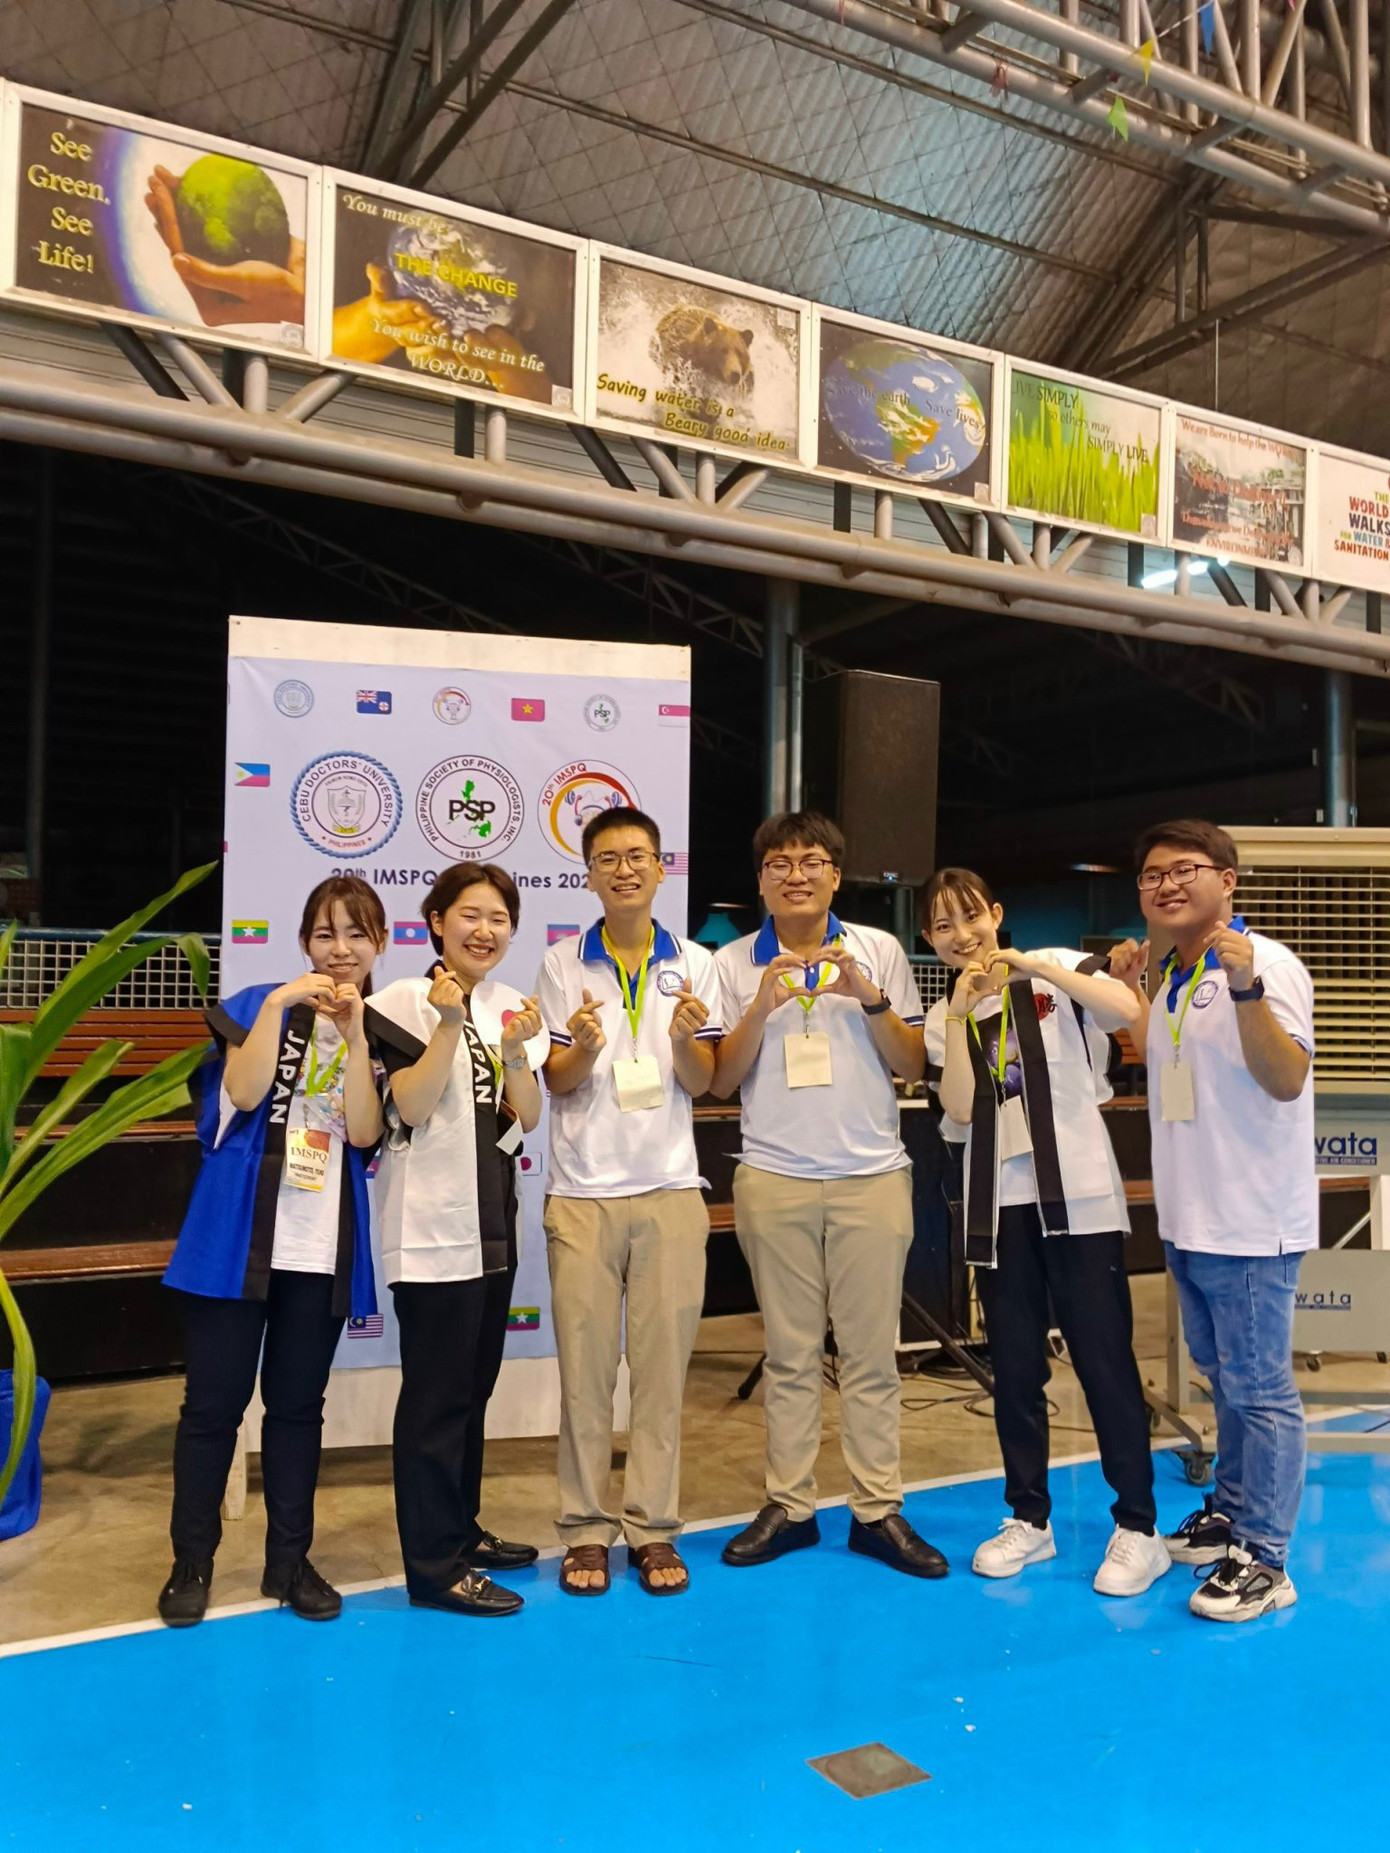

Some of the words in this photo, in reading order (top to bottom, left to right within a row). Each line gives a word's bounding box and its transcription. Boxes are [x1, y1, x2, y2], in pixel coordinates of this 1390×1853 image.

[50, 132, 92, 161] See
[51, 207, 93, 237] See
[342, 194, 378, 217] You
[382, 206, 421, 228] must
[38, 240, 94, 274] Life!
[395, 252, 432, 276] THE
[438, 264, 518, 298] CHANGE
[373, 318, 402, 339] You
[409, 331, 448, 349] wish
[452, 338, 469, 354] to
[472, 345, 496, 360] see
[499, 348, 516, 365] in
[520, 353, 545, 372] the
[596, 373, 647, 402] Saving
[655, 390, 700, 411] water
[707, 399, 719, 414] is
[726, 406, 735, 418] a
[1036, 385, 1079, 410] SIMPLY
[925, 400, 952, 417] Save
[664, 412, 707, 436] Beary
[714, 427, 751, 443] good
[1091, 422, 1111, 438] may
[1087, 435, 1124, 457] SIMPLY
[1349, 496, 1389, 518] WORLD
[1375, 491, 1389, 504] THE
[1349, 513, 1390, 537] WALKS
[1334, 540, 1389, 561] SANITATION
[1354, 531, 1383, 547] WATER
[425, 760, 459, 789] SOCIETY
[462, 758, 475, 767] OF
[300, 789, 311, 822] CEBU
[362, 764, 393, 827] UNIVERSITY
[542, 783, 554, 806] 20th
[553, 762, 587, 786] IMSPQ
[420, 790, 439, 842] PHILIPPINE
[449, 799, 496, 822] PSP
[460, 850, 481, 859] 1981
[374, 869, 438, 886] IMSPQ
[558, 873, 589, 889] 202
[269, 1030, 306, 1124] JAPAN
[291, 1146, 328, 1165] IMSPQ
